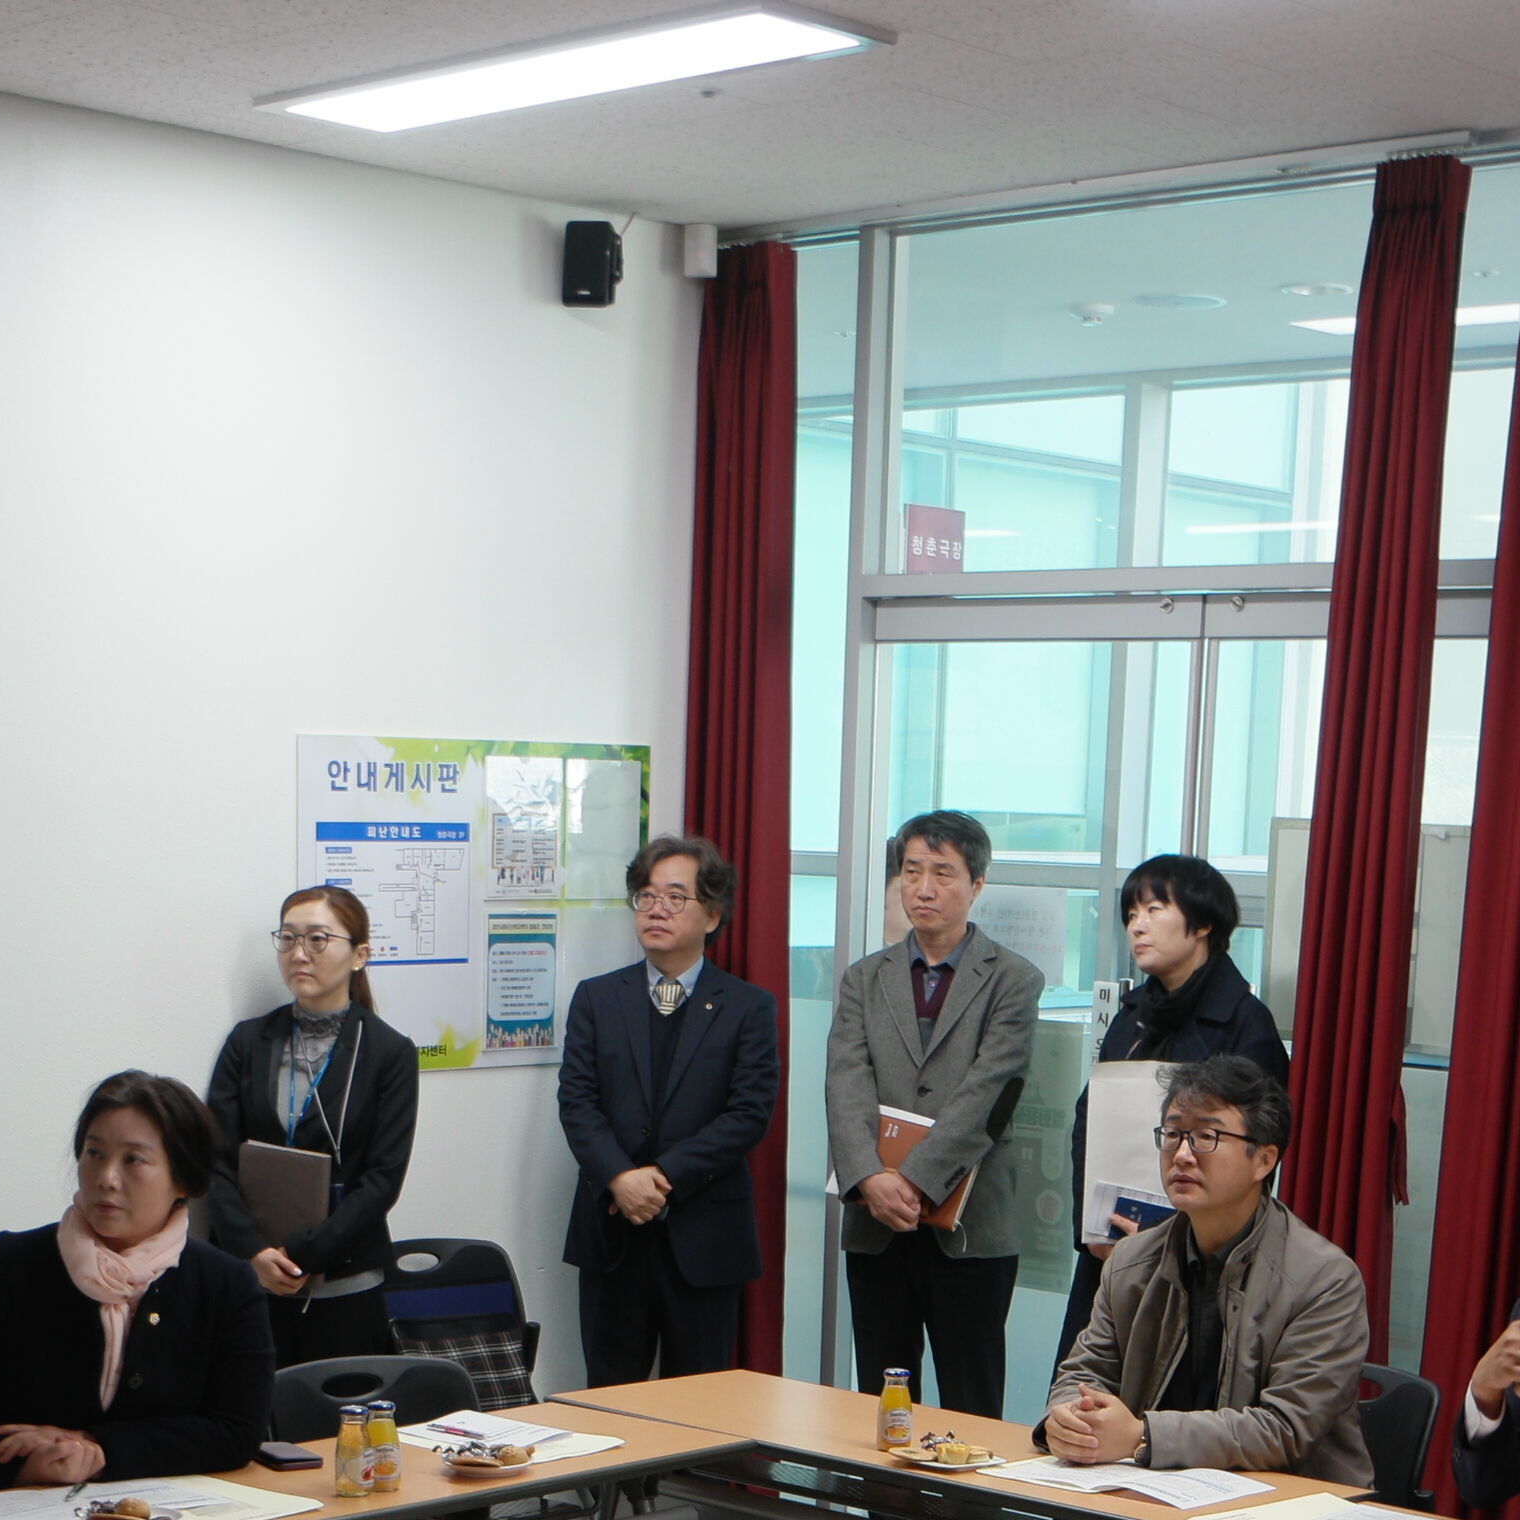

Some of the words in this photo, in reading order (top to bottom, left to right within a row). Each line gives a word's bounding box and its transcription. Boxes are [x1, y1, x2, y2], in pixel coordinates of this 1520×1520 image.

[911, 535, 962, 561] 청춘극장
[326, 759, 461, 795] 안내게시판
[367, 826, 422, 839] 피난안내도
